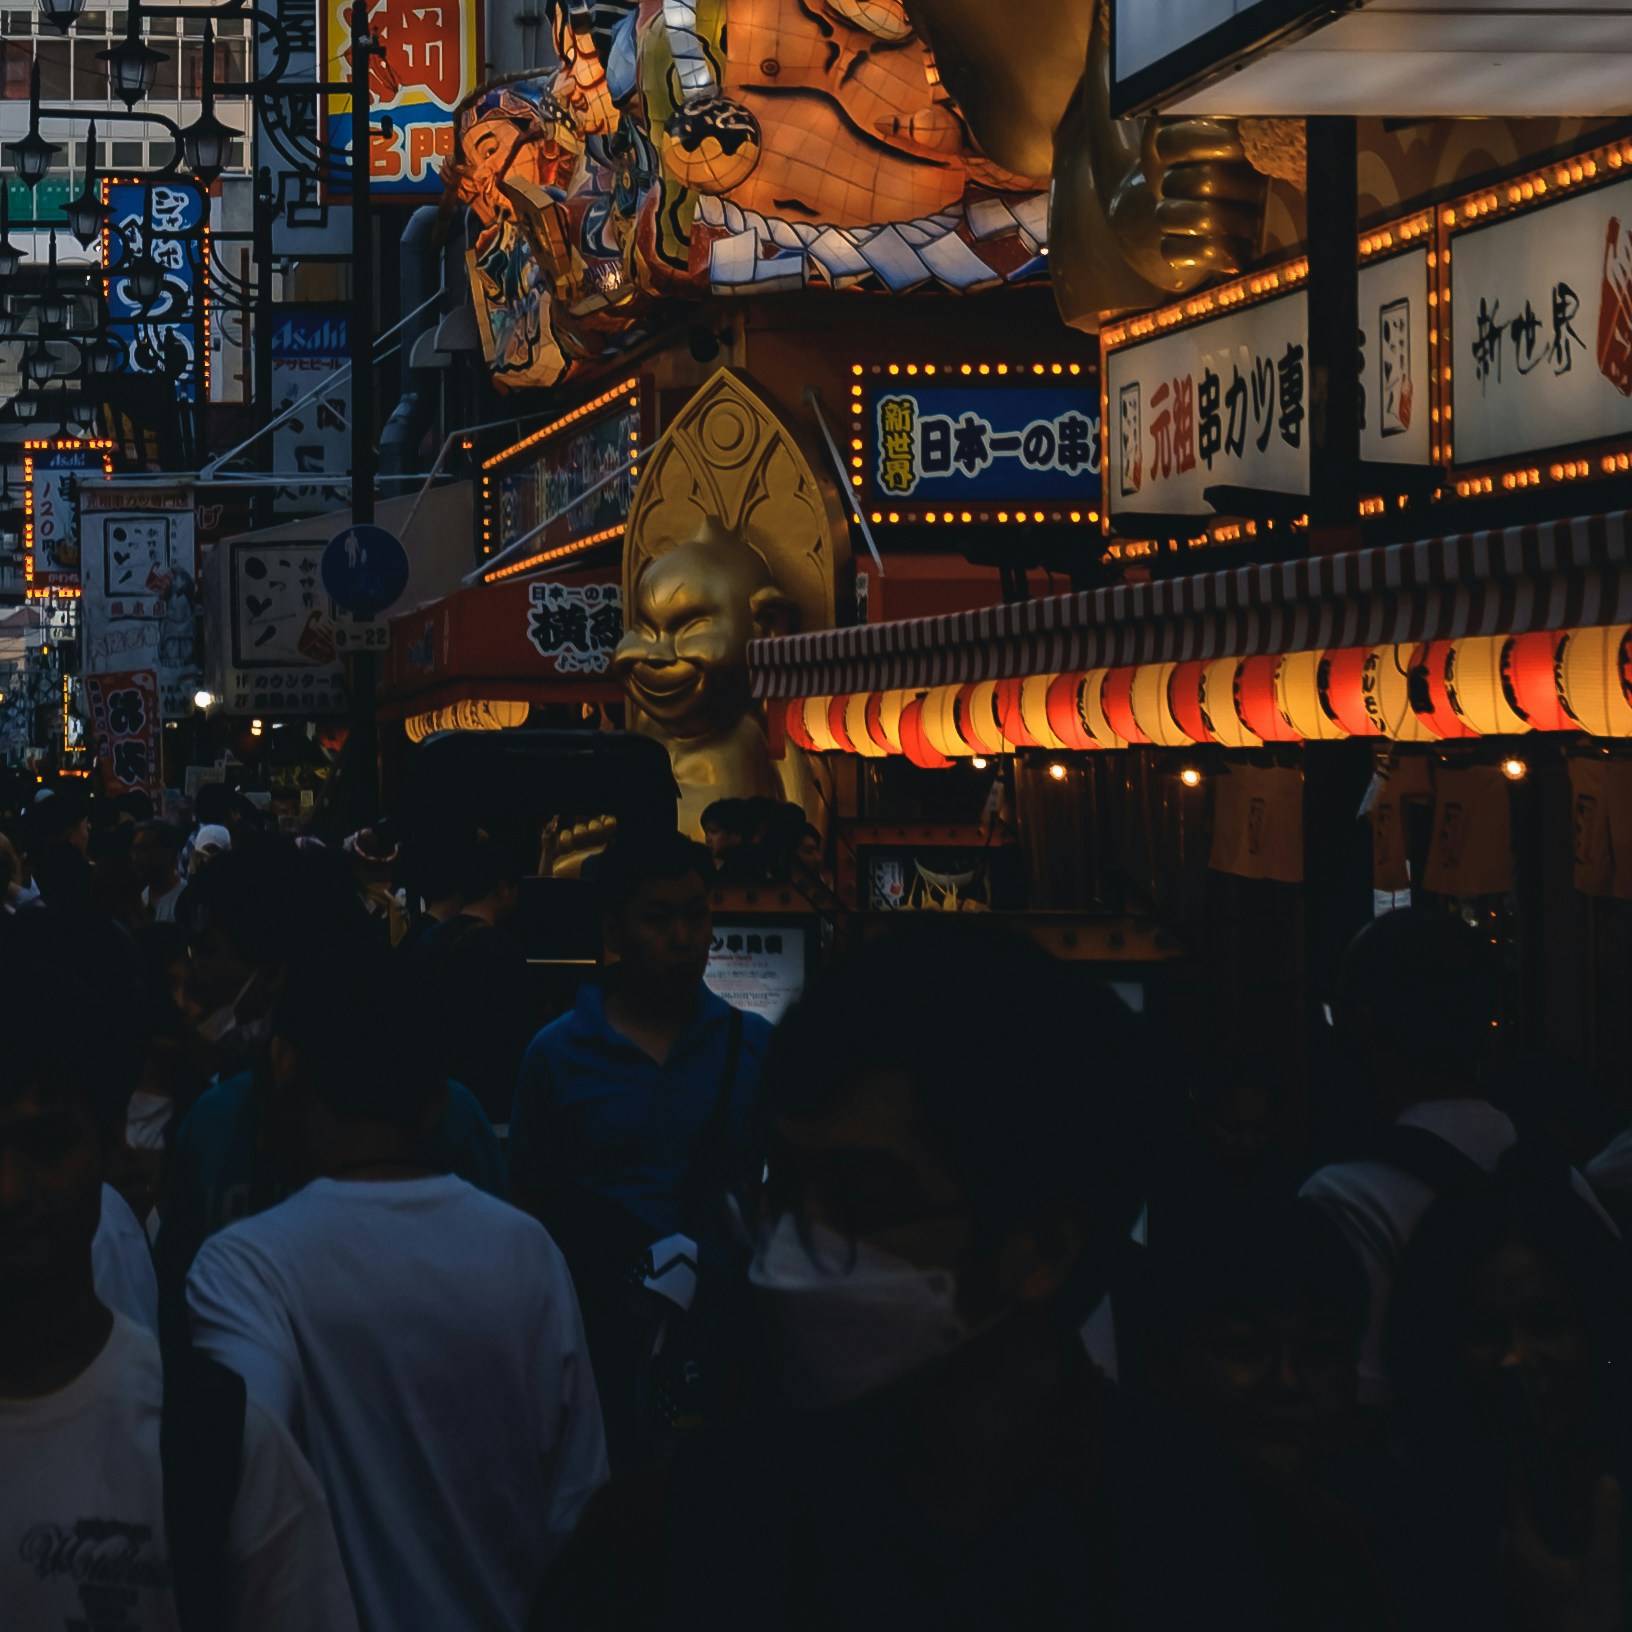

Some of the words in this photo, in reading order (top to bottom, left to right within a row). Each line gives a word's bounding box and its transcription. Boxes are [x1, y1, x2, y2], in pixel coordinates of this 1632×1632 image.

[272, 320, 347, 350] Asahi
[274, 358, 344, 371] アサヒビール
[1470, 281, 1586, 396] 新世界
[882, 399, 916, 492] 新世界
